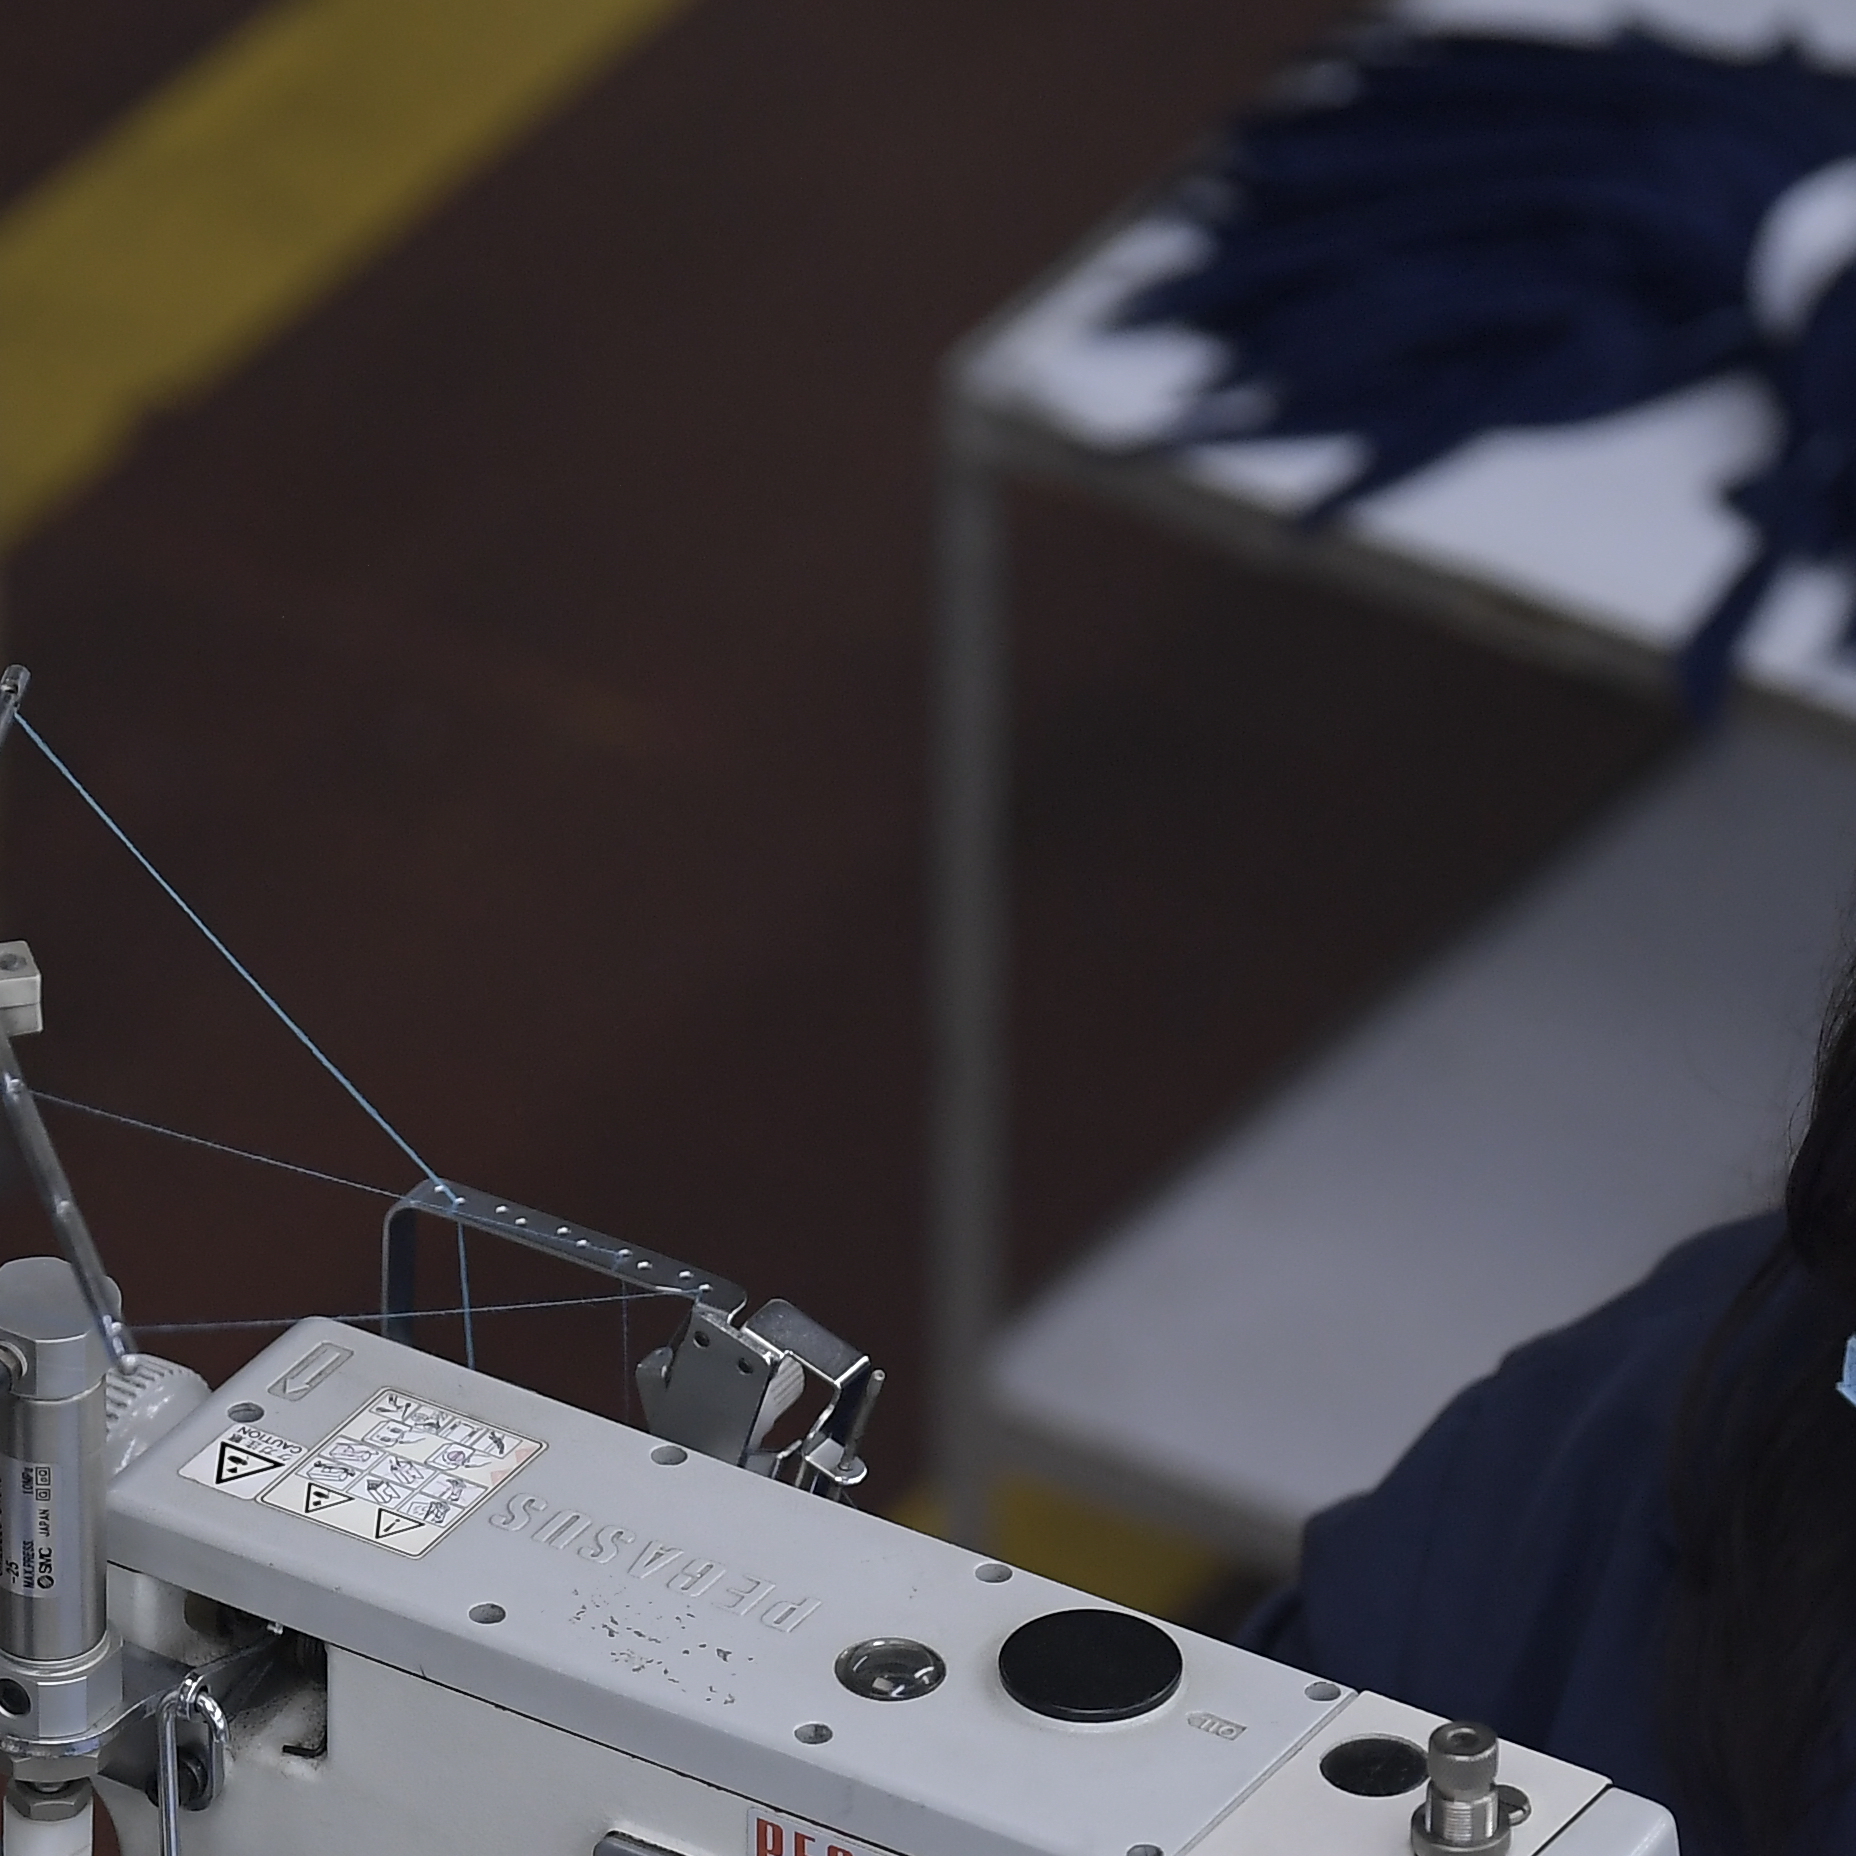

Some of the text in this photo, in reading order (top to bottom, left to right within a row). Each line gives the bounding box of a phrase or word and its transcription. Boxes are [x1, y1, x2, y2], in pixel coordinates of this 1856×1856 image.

[237, 1426, 303, 1454] CAUTION
[38, 1508, 50, 1537] JAPAN
[38, 1547, 52, 1574] SMC
[488, 1493, 822, 1633] PEGASUS
